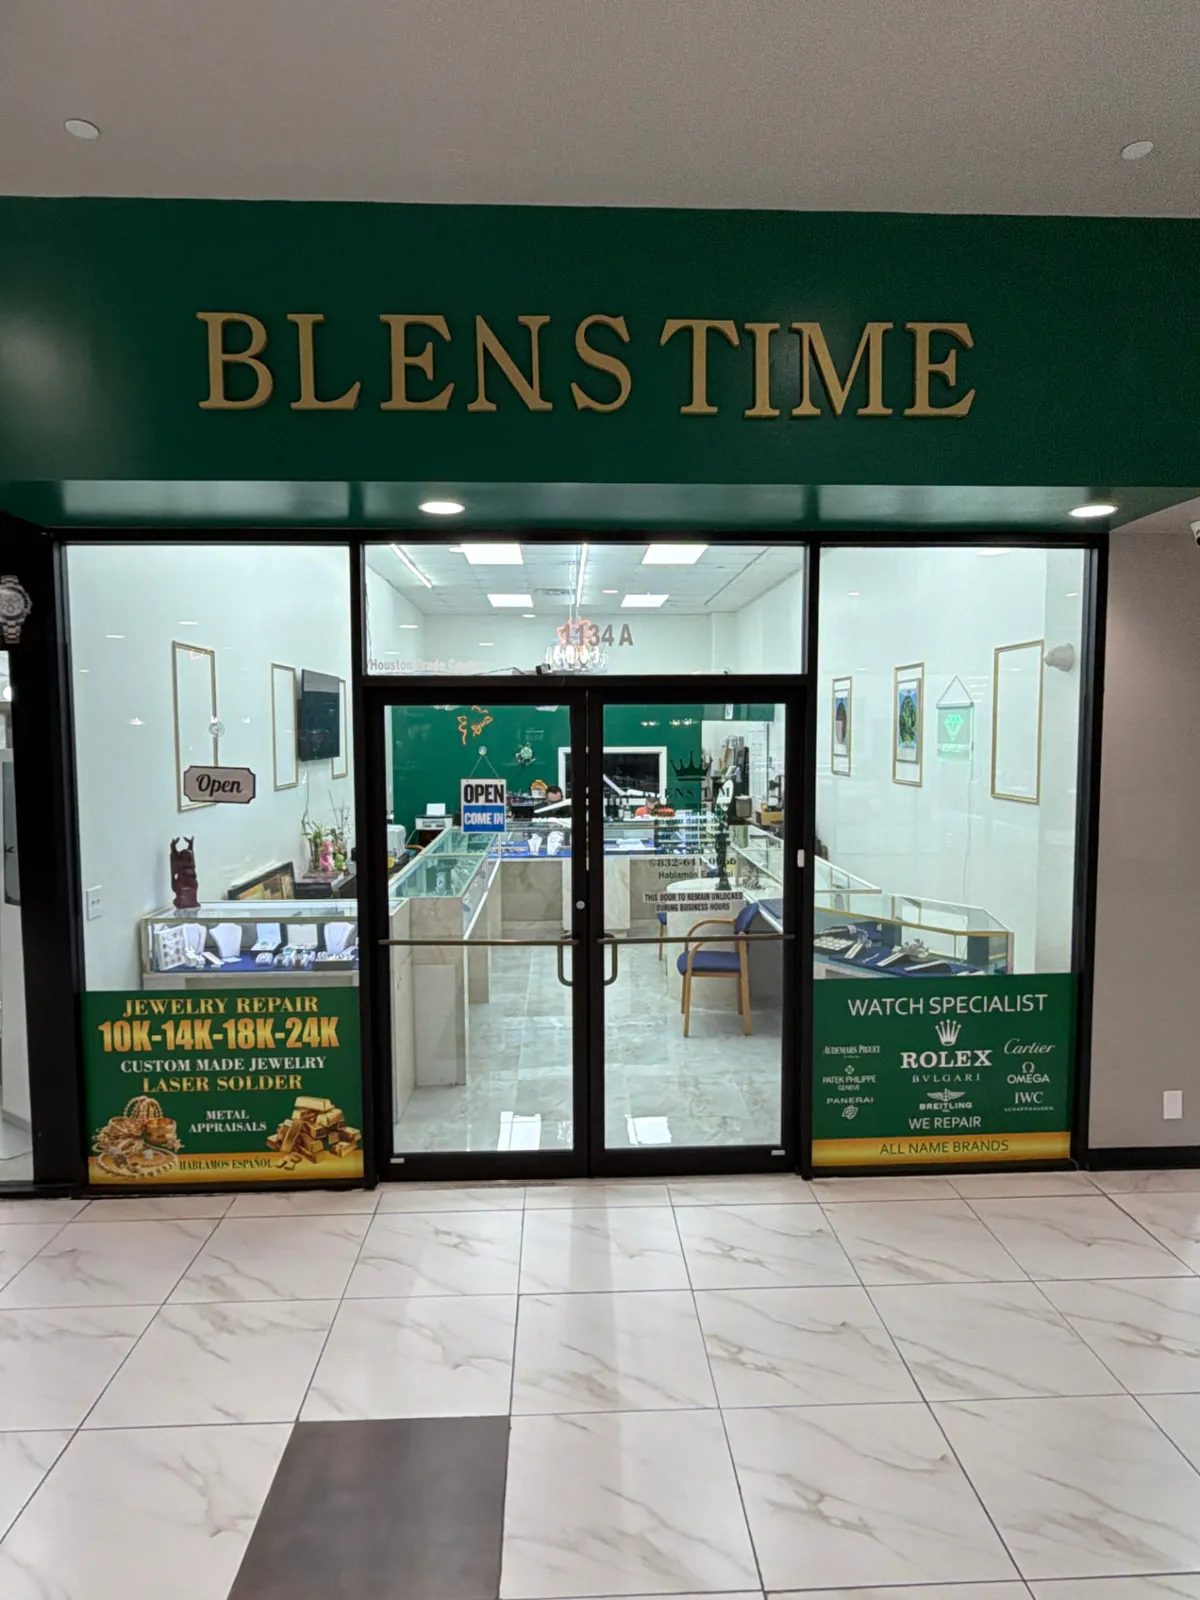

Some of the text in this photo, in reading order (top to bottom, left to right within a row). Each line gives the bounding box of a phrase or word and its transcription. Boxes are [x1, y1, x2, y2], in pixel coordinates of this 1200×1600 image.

[196, 311, 977, 419] BLENS TIME
[562, 622, 634, 647] 1134 A
[369, 658, 413, 671] Houston
[195, 773, 243, 798] Open
[463, 783, 505, 804] OPEN
[464, 812, 504, 825] COME IN
[645, 891, 743, 902] THIS DOOR TO REMAIN UNLOCKED
[656, 902, 730, 912] DURING BUSINESS HOURS
[122, 996, 319, 1018] JEWELRY REPAIR
[848, 994, 1048, 1016] WATCH SPECIALIST
[98, 1016, 340, 1052] 10K-14K-18K-24K
[1003, 1038, 1056, 1055] Cartier
[120, 1056, 327, 1073] CUSTOM MADE JEWELRY
[900, 1049, 993, 1069] ROLEX
[142, 1075, 303, 1093] LASER SOLDER
[822, 1076, 845, 1084] PATEK
[912, 1073, 981, 1083] BVLGARI
[1006, 1073, 1050, 1084] OMEGA
[826, 1096, 874, 1104] PANERAI
[1014, 1091, 1044, 1104] IWC
[919, 1101, 973, 1111] BREITLING
[206, 1109, 250, 1120] METAL
[188, 1121, 267, 1133] APPRAISALS
[908, 1116, 982, 1130] WE REPAIR
[880, 1139, 1009, 1156] ALL NAME BRANDS
[179, 1156, 274, 1171] HABLAMOS ESPAÑOL
